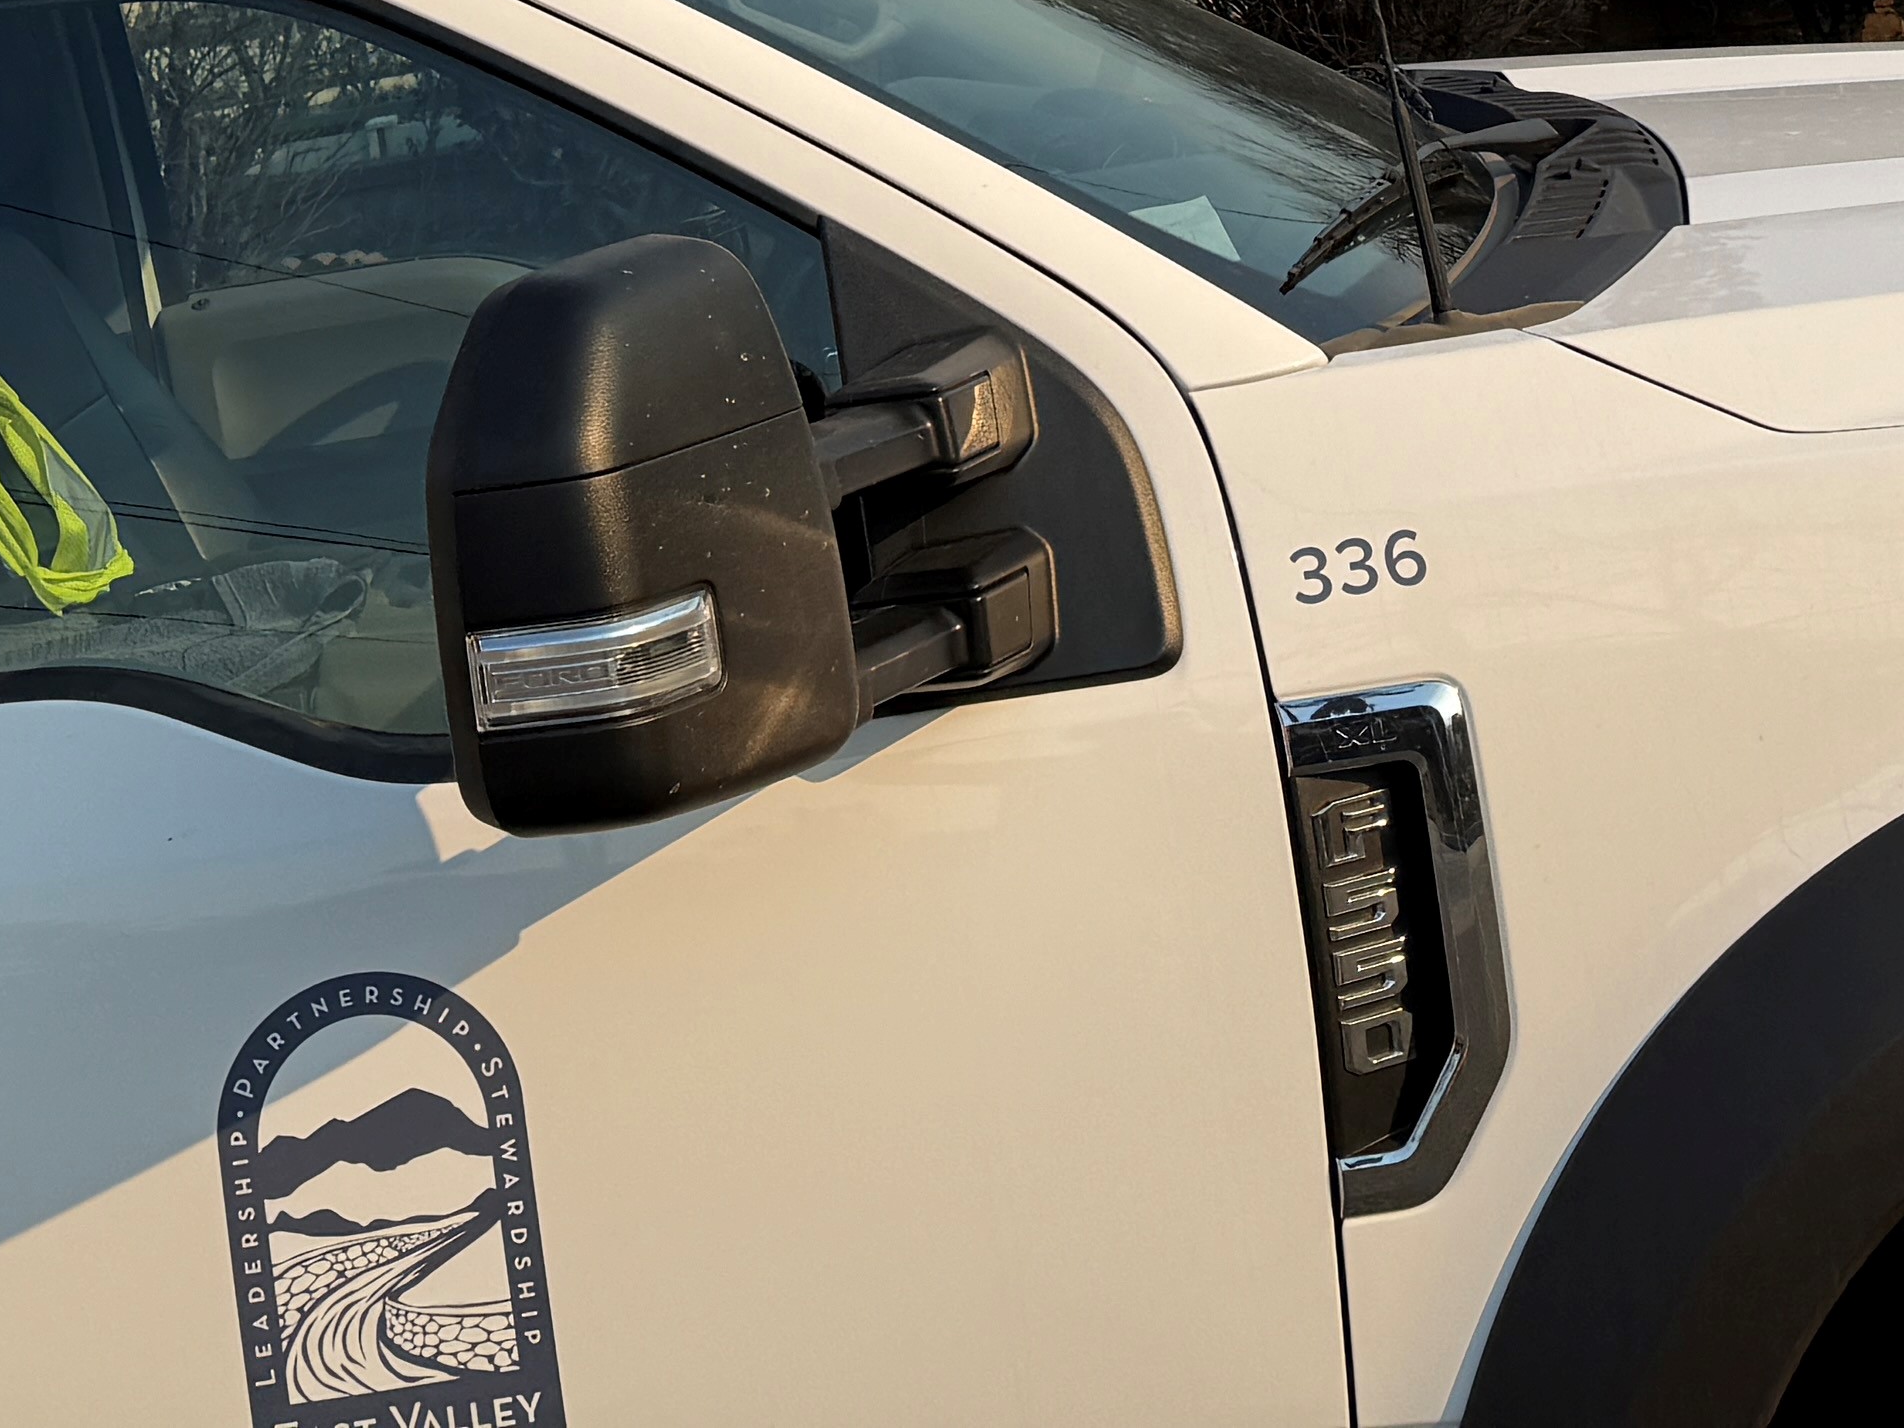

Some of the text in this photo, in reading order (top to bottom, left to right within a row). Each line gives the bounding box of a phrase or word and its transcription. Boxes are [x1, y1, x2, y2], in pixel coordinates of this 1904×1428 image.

[1289, 529, 1427, 604] 336
[1312, 788, 1415, 1075] F550
[229, 987, 542, 1388] LEADERSHIP PARTNERSHIP STEWARDSHIP
[390, 1392, 543, 1428] VALLEY
